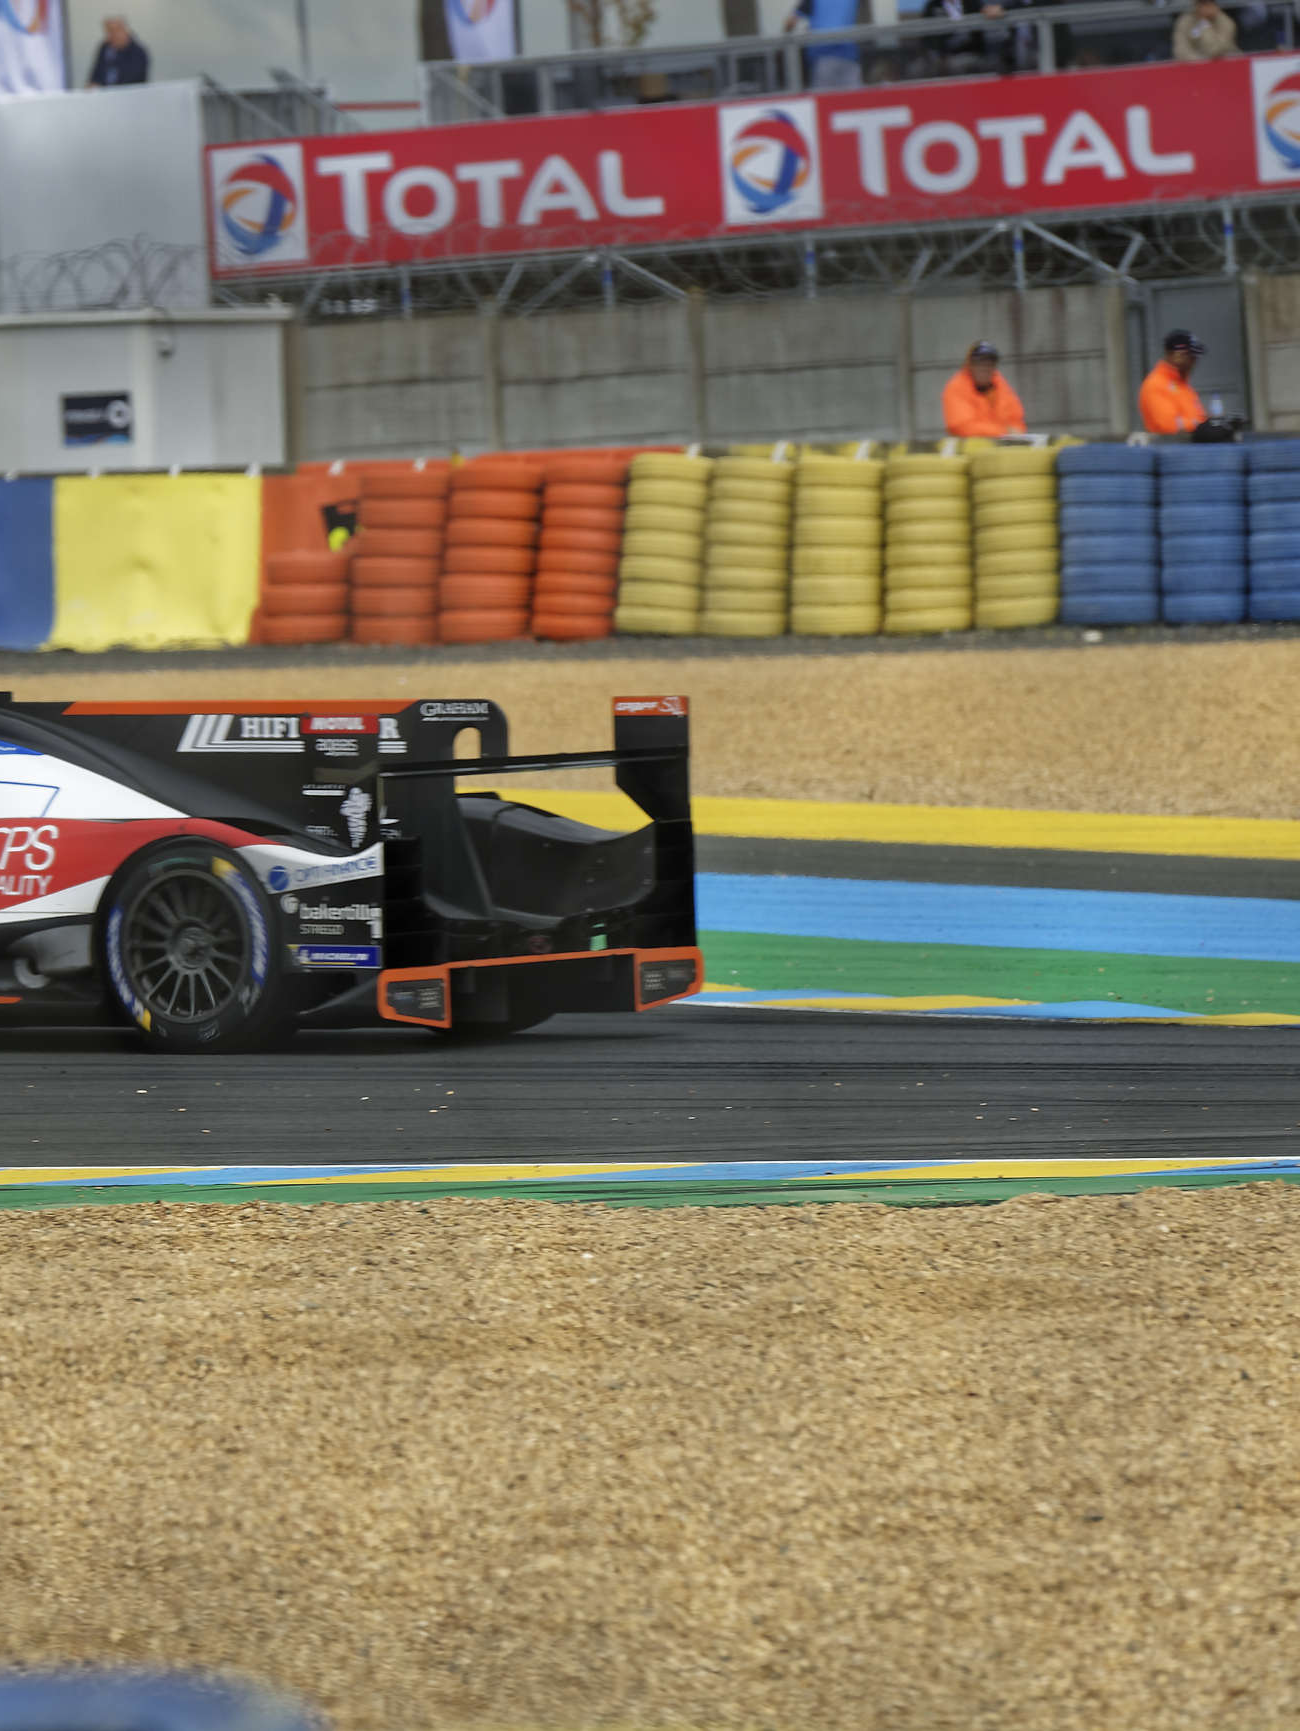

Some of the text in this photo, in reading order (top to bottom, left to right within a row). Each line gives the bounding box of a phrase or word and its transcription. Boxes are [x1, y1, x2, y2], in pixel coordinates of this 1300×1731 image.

[830, 104, 1195, 198] TOTAL
[314, 150, 666, 239] TOTAL
[240, 716, 300, 738] HIFI
[310, 716, 366, 731] MOTUL
